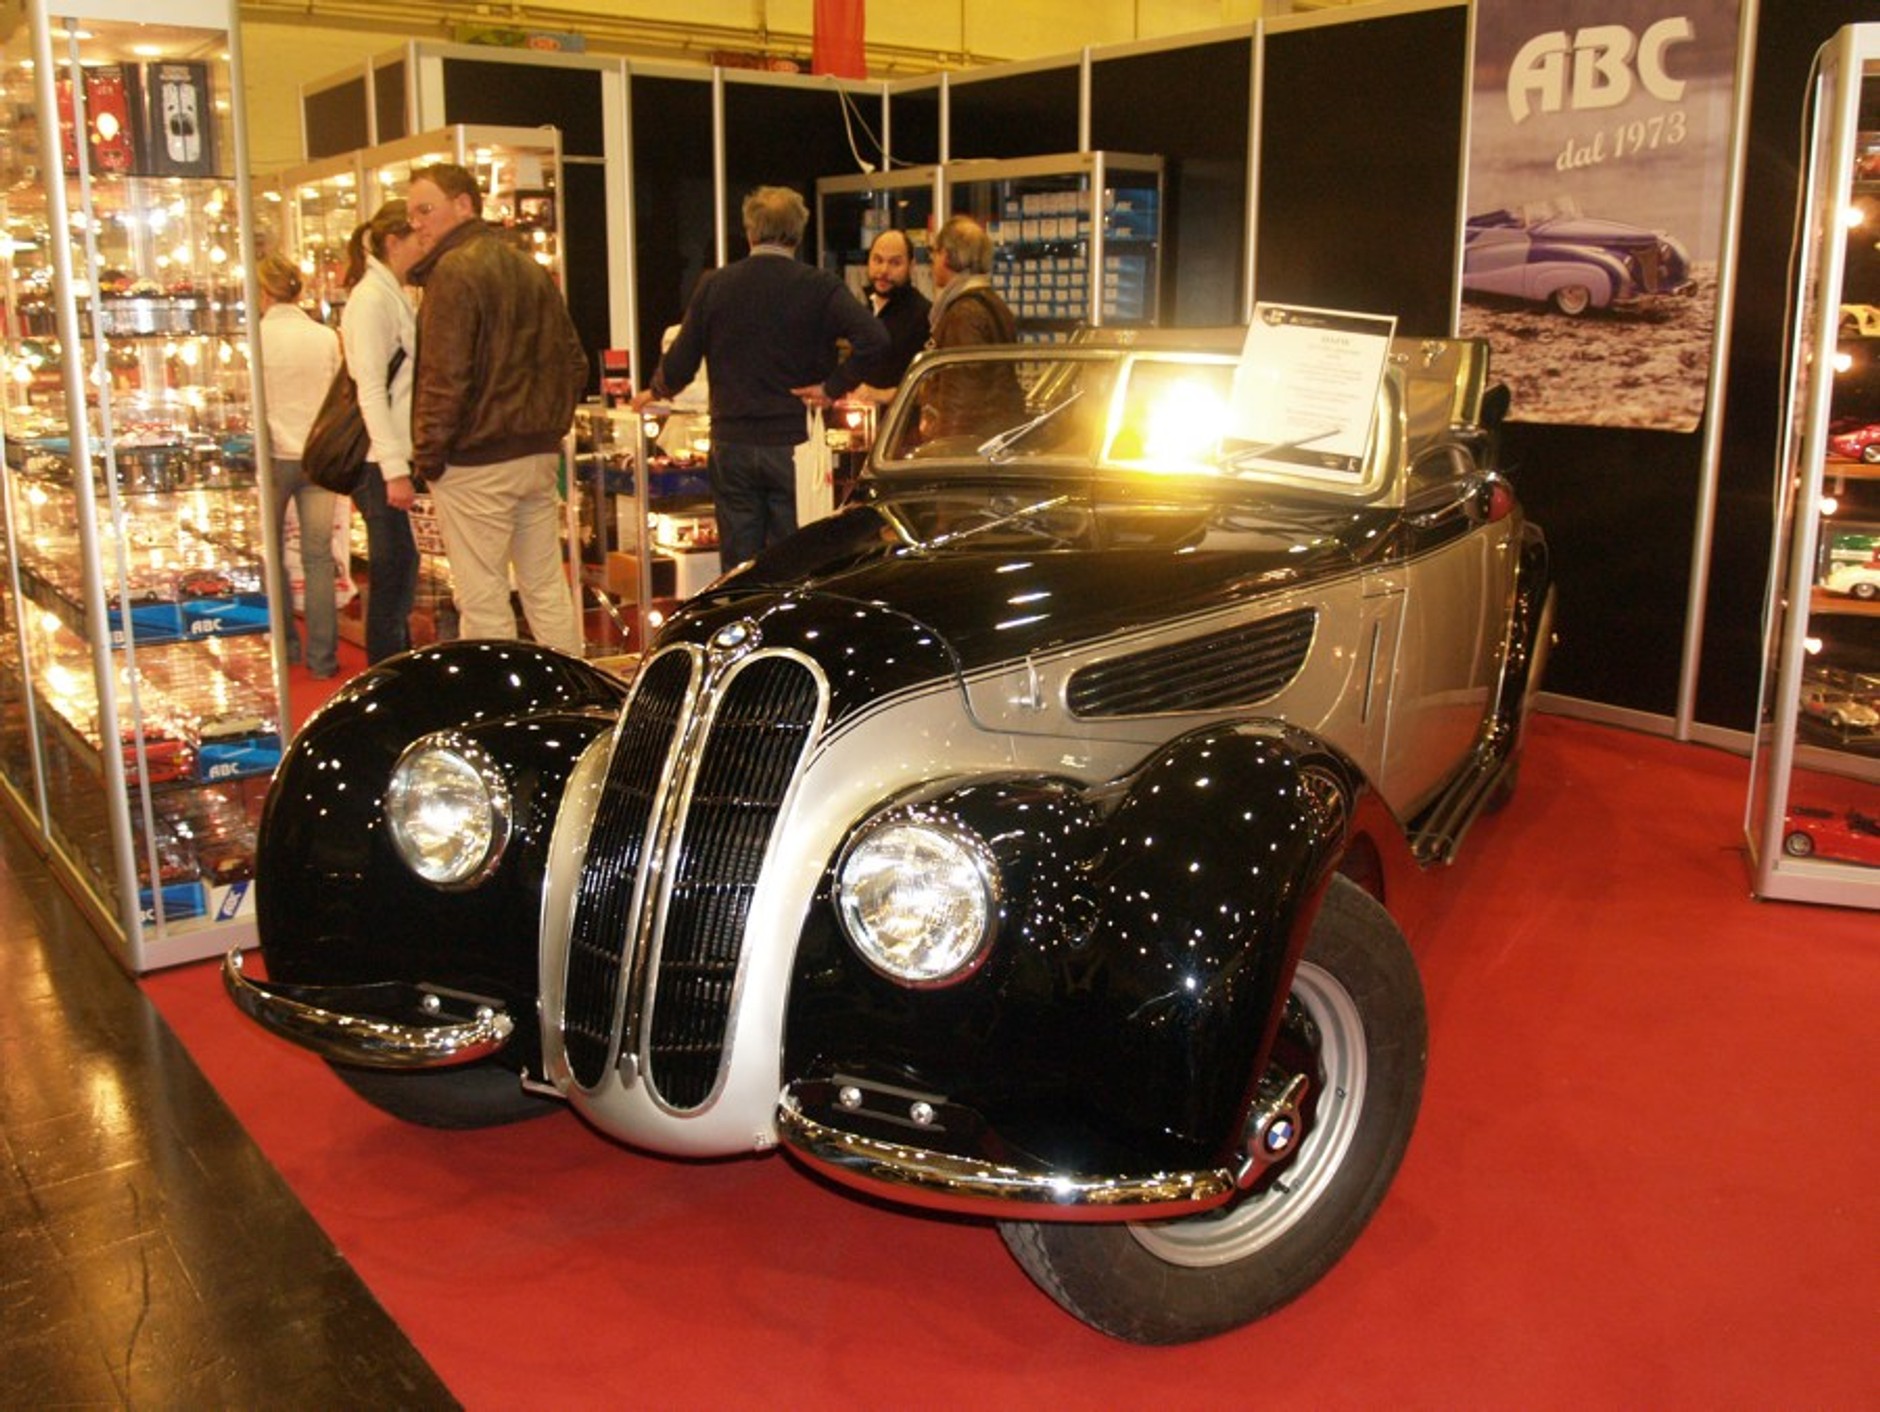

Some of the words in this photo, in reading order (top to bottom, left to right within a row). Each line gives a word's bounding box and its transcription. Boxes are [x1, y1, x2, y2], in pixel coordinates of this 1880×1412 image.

[1507, 17, 1692, 124] ABC
[1556, 131, 1606, 171] dal
[1614, 111, 1687, 158] 1973
[191, 618, 224, 635] ABC
[209, 762, 240, 779] ABC
